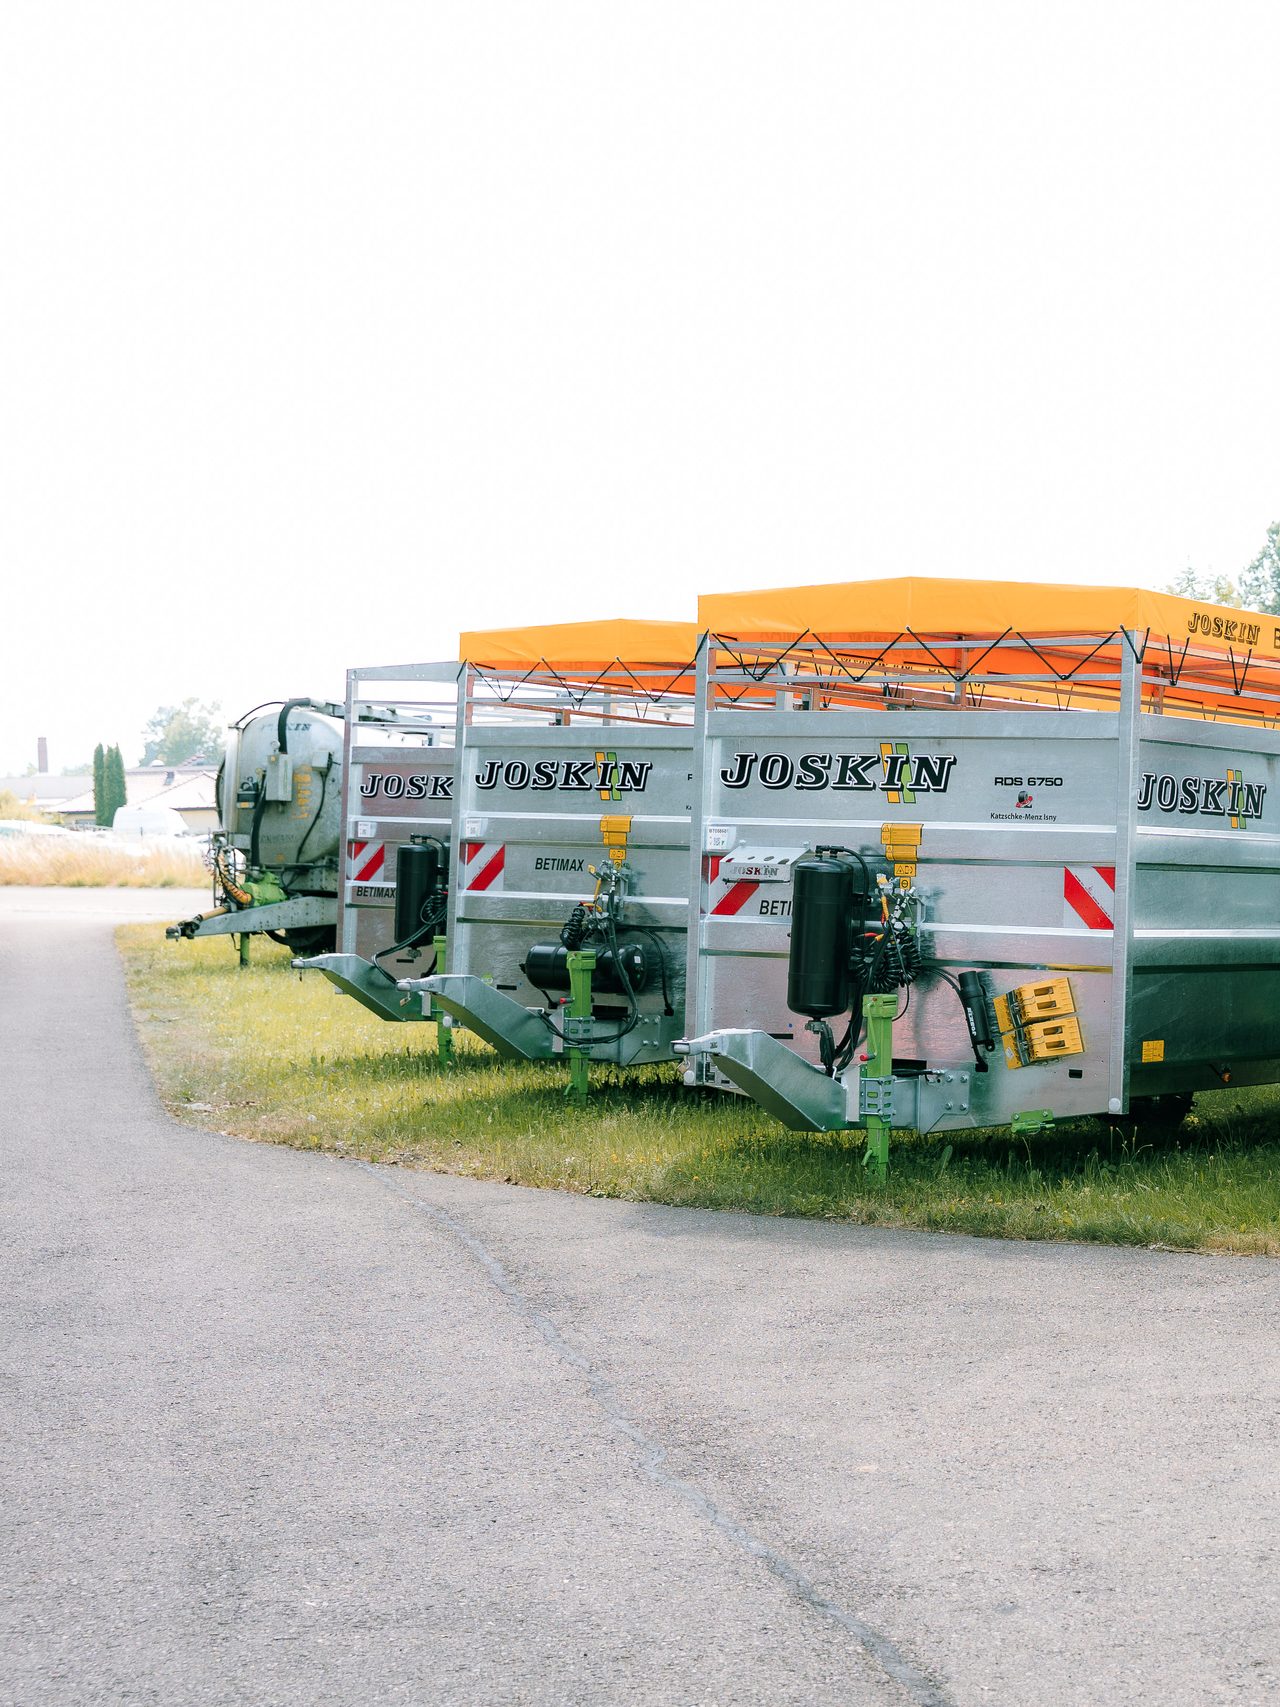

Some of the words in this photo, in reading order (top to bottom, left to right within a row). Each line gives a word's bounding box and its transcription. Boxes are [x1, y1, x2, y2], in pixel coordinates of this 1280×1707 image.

[1187, 612, 1260, 646] JOSKIN
[475, 760, 653, 792] JOSKIN
[719, 752, 957, 793] JOSKIN
[994, 777, 1023, 786] RDS
[1027, 777, 1063, 787] 6750
[1136, 772, 1266, 819] JOSKIN
[990, 813, 1043, 821] Katzschke-Menz
[1043, 813, 1057, 822] Isny
[535, 857, 585, 872] BETIMAX
[731, 866, 780, 877] JOSKIN
[356, 886, 396, 899] BETIMAX
